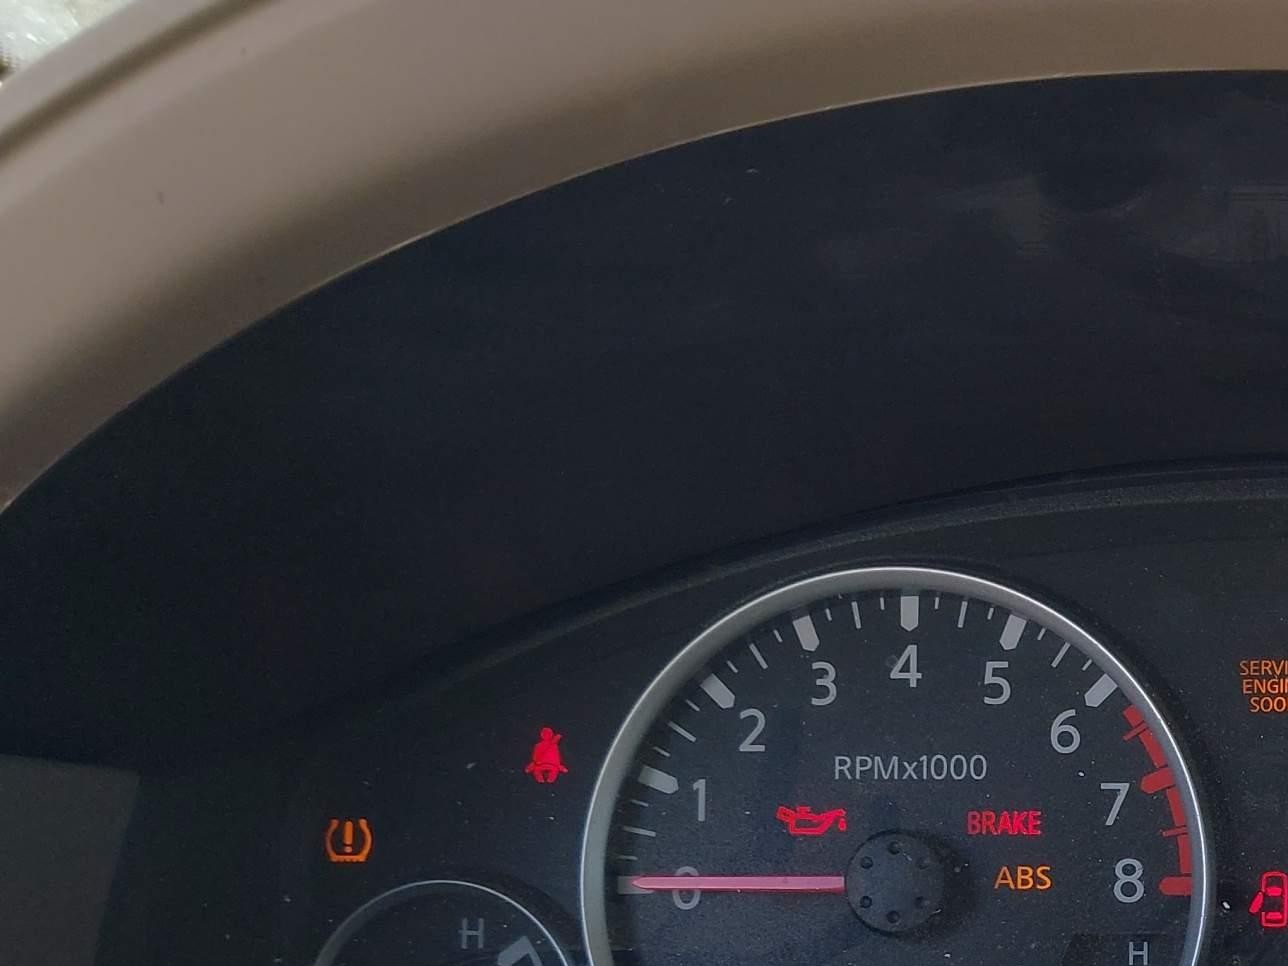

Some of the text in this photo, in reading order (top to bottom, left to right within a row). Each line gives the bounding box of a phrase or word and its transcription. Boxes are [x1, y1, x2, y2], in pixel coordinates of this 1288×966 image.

[811, 662, 837, 705] 3
[890, 645, 922, 688] 4
[984, 662, 1010, 705] 5
[739, 709, 766, 752] 2
[1051, 710, 1080, 753] 6
[693, 779, 706, 821] 1
[1101, 783, 1130, 825] 7
[967, 811, 1042, 836] BRAKE
[994, 866, 1052, 890] ABS
[1114, 859, 1144, 903] 8
[460, 918, 484, 949] H
[1129, 942, 1149, 966] H
